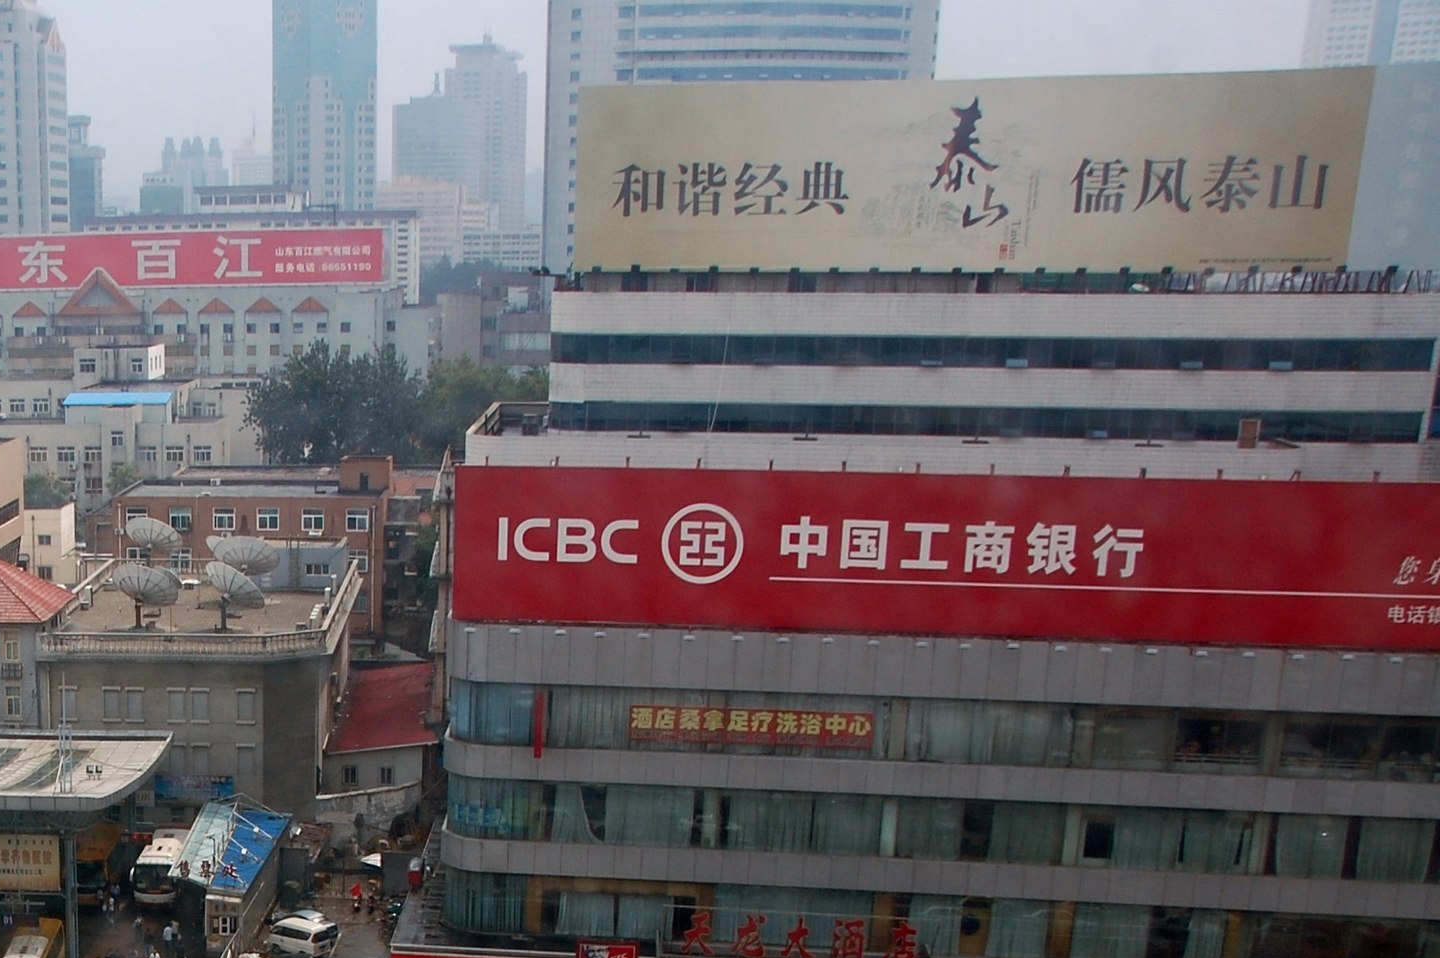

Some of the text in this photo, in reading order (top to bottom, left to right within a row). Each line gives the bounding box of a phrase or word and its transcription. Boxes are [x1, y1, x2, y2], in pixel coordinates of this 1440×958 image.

[611, 162, 849, 217] 和谐经典
[929, 95, 1009, 229] 泰山
[1069, 155, 1330, 213] 儒风泰山
[275, 245, 371, 257] 山东百江燃气有限公司
[498, 516, 639, 565] ICBC
[778, 514, 1146, 579] 中国工商银行
[631, 707, 872, 737] 酒店桑拿足疗洗浴中心
